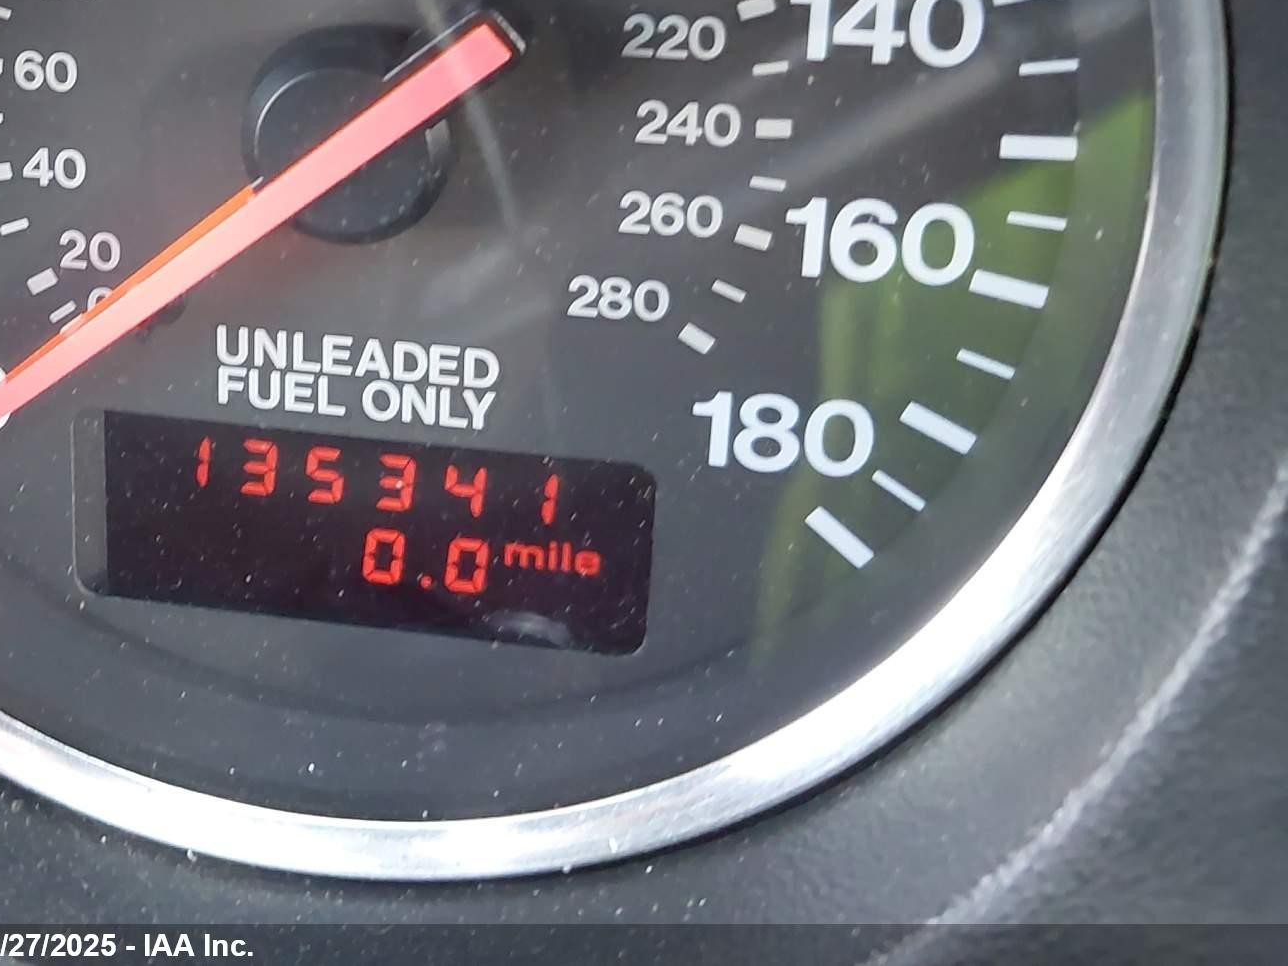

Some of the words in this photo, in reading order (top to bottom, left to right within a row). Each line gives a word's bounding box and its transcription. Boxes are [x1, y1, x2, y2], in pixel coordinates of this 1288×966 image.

[621, 12, 728, 62] 220
[13, 50, 78, 93] 60
[634, 99, 742, 148] 240
[22, 147, 87, 190] 40
[617, 190, 724, 238] 260
[58, 229, 122, 272] 20
[785, 196, 975, 286] 160
[566, 274, 671, 323] 280
[215, 324, 500, 389] UNLEADED
[216, 366, 346, 416] FUEL
[361, 379, 497, 430] ONLY
[692, 391, 875, 478] 180
[195, 435, 559, 526] 135341
[362, 527, 488, 595] 0.0
[503, 537, 601, 578] mile
